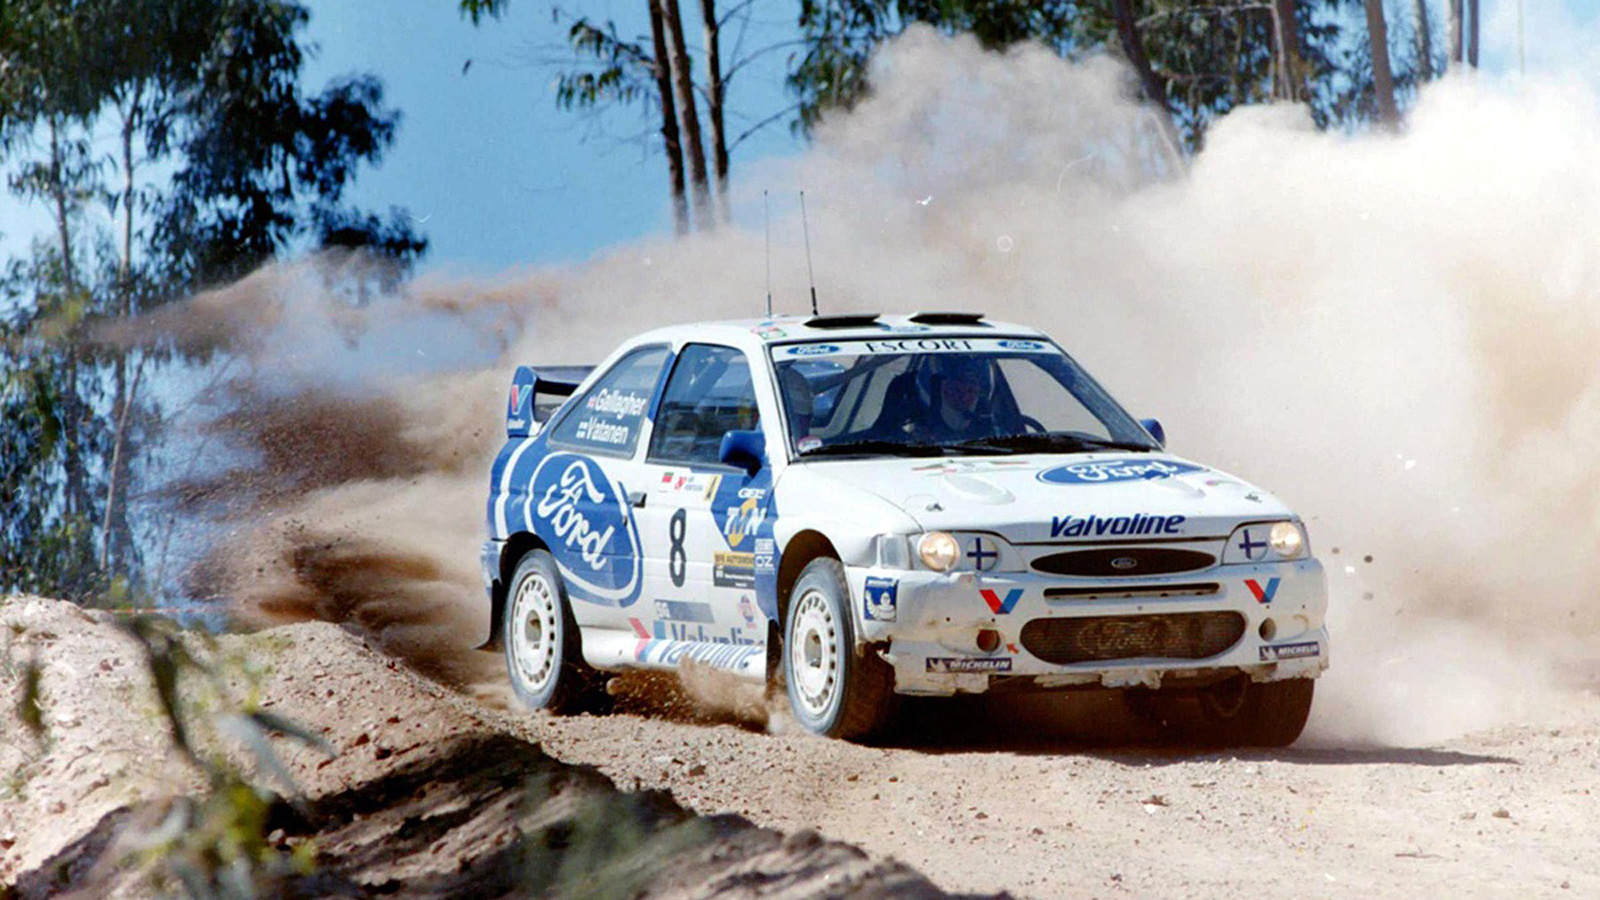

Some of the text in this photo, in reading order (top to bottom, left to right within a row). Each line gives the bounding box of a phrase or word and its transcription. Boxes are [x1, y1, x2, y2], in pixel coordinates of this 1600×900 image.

[865, 340, 972, 353] ESCORT
[595, 388, 646, 419] Gallagher
[586, 417, 629, 444] Vatanen
[1066, 460, 1178, 481] Ford
[537, 460, 615, 570] Ford
[1050, 513, 1185, 538] Valvoline
[669, 508, 687, 588] 8
[755, 556, 774, 568] OZ
[1278, 644, 1318, 656] MICHELIN
[950, 659, 1010, 670] MICHELIN
